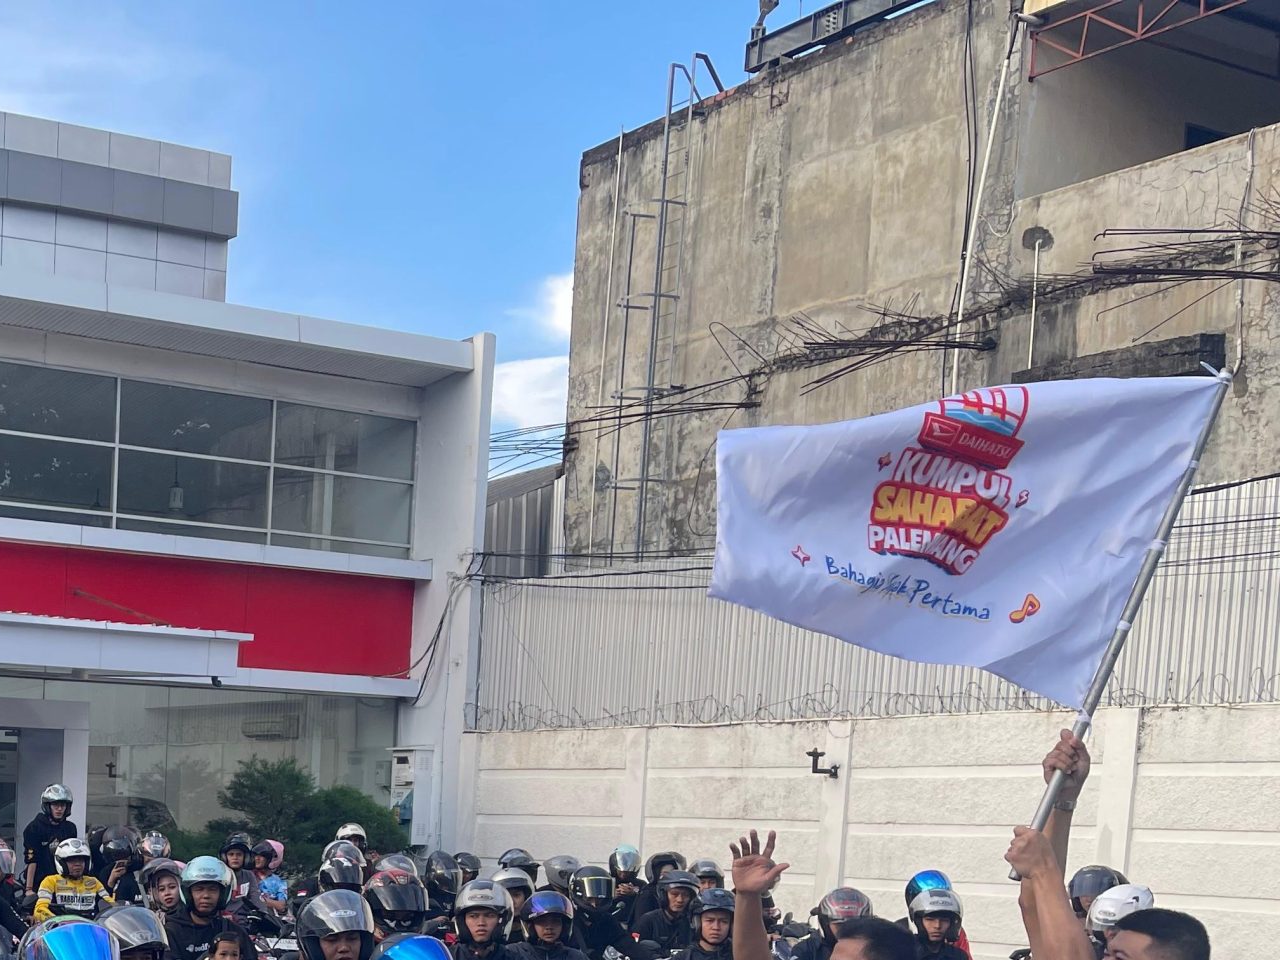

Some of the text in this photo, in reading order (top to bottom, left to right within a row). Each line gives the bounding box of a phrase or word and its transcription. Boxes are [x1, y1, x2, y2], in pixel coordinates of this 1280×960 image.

[958, 431, 1013, 459] DAIHATSU
[894, 450, 1011, 505] KUMPUL
[908, 579, 991, 620] Pertama
